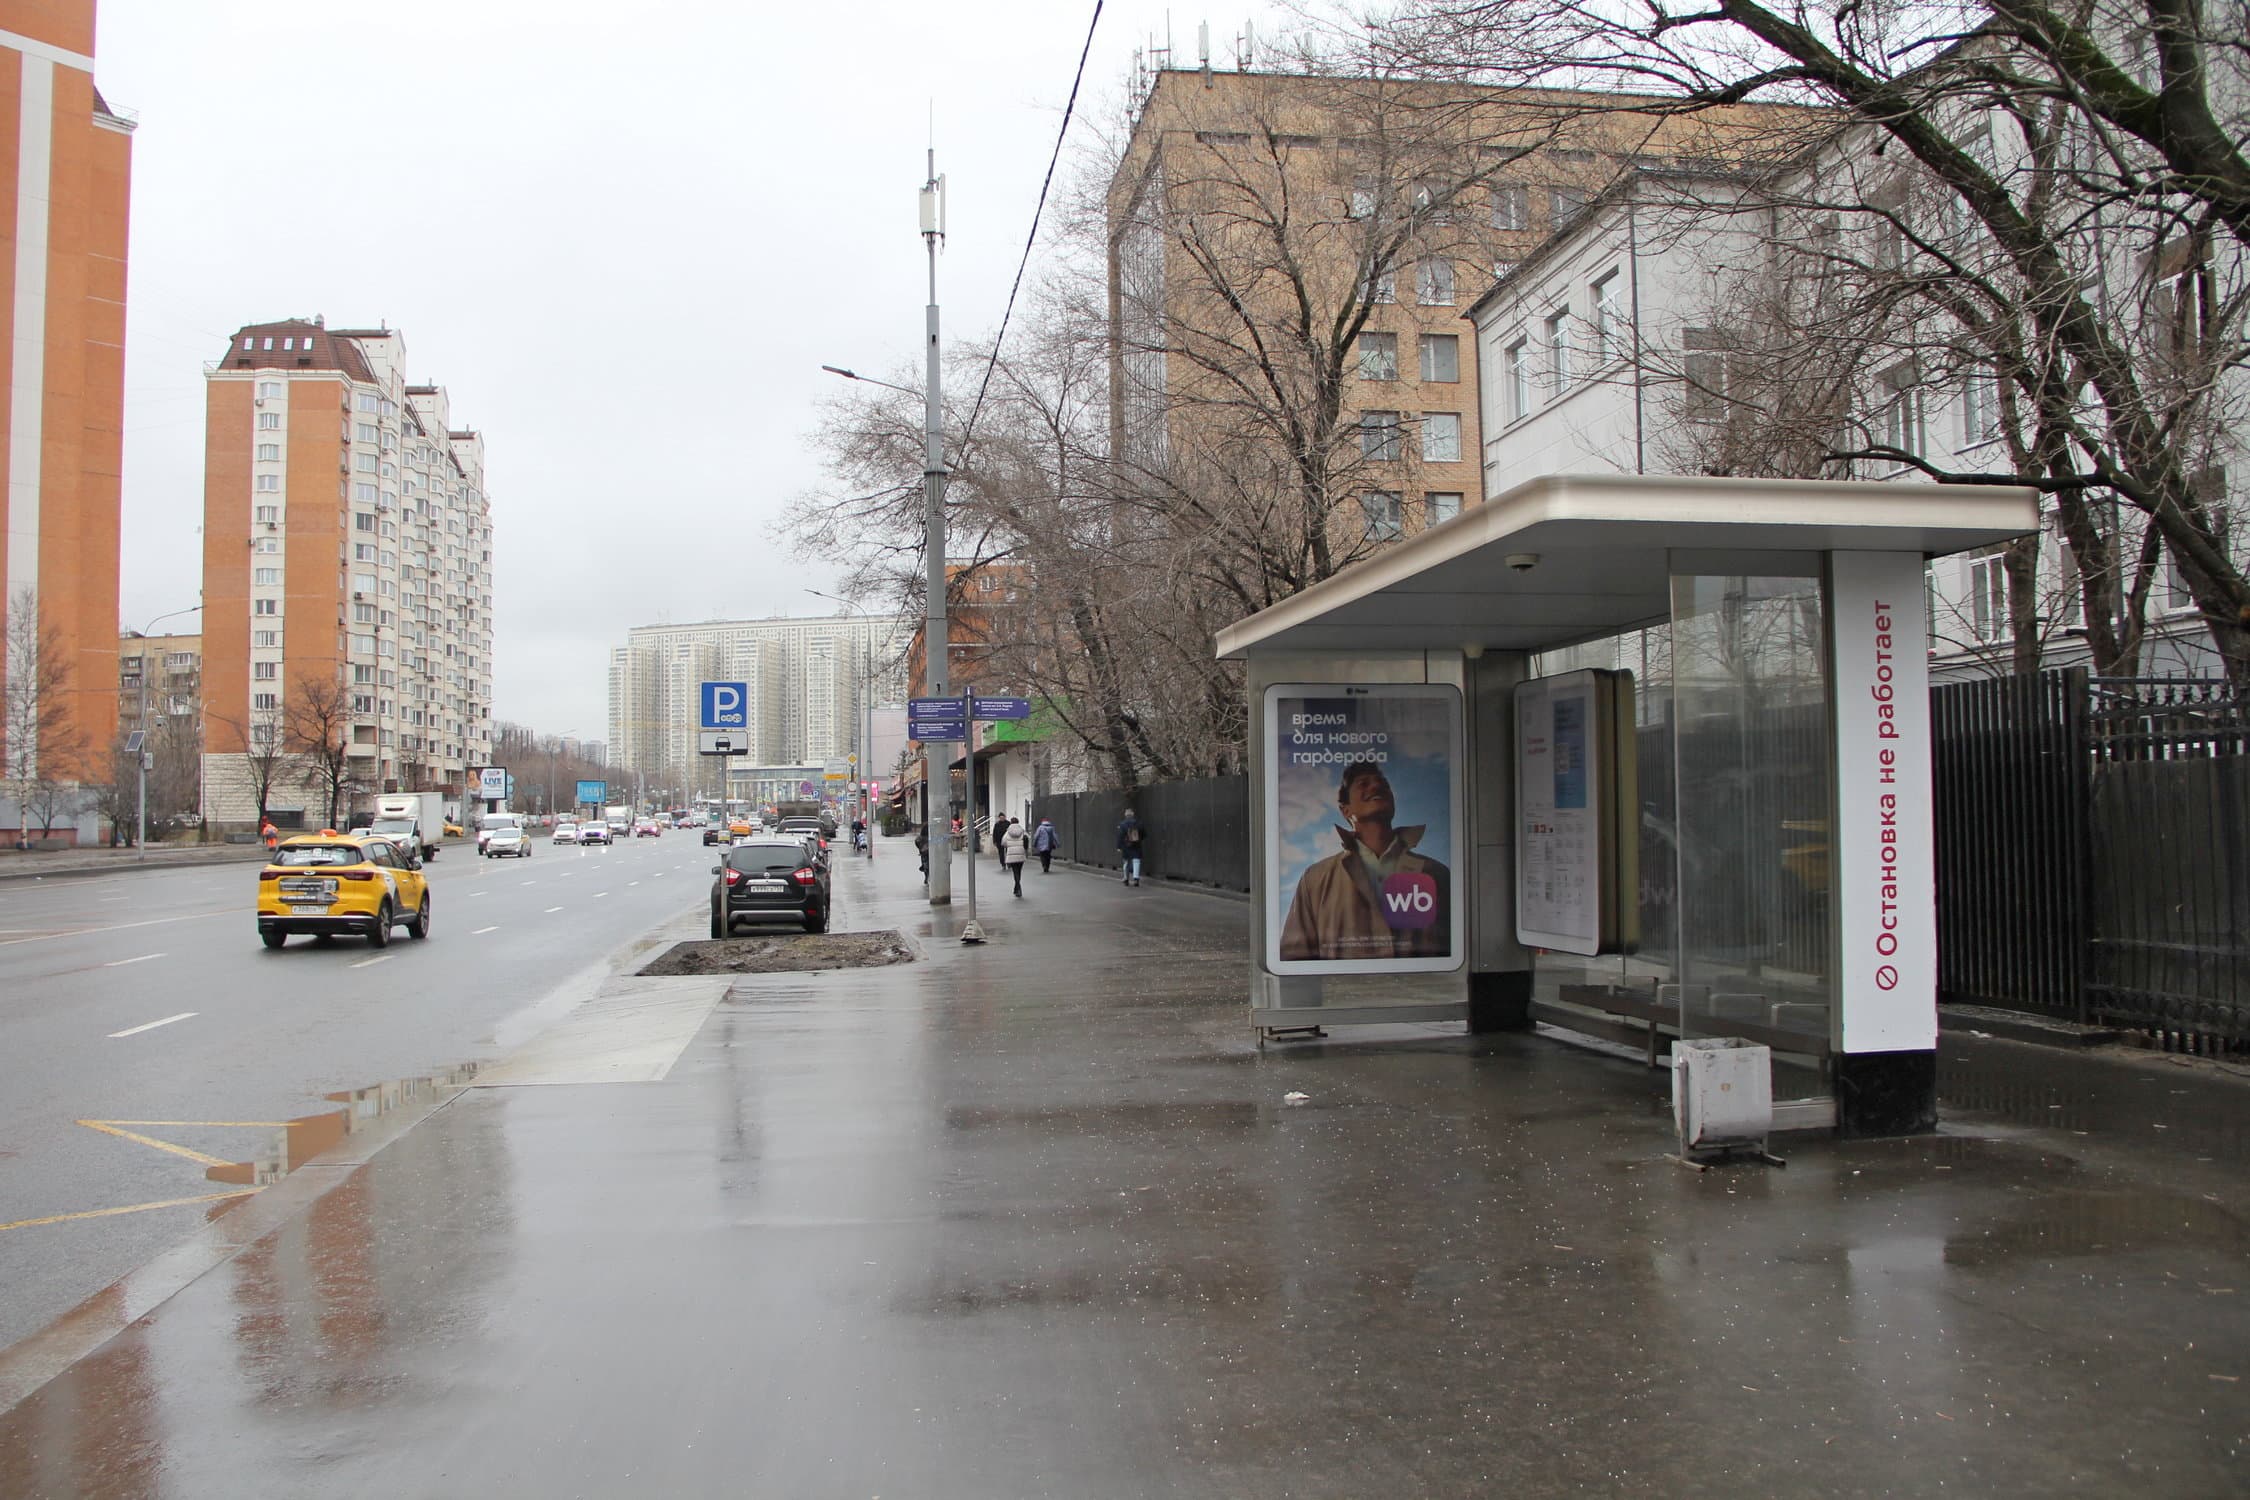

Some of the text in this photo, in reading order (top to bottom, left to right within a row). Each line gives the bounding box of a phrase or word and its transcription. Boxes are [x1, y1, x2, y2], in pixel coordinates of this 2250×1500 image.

[713, 686, 740, 724] P
[1292, 713, 1346, 728] время
[1292, 729, 1388, 745] для нового
[1293, 747, 1388, 767] гардероба
[484, 777, 502, 785] LIVE
[1871, 600, 1899, 956] Остановка не работает
[1385, 884, 1433, 912] wb
